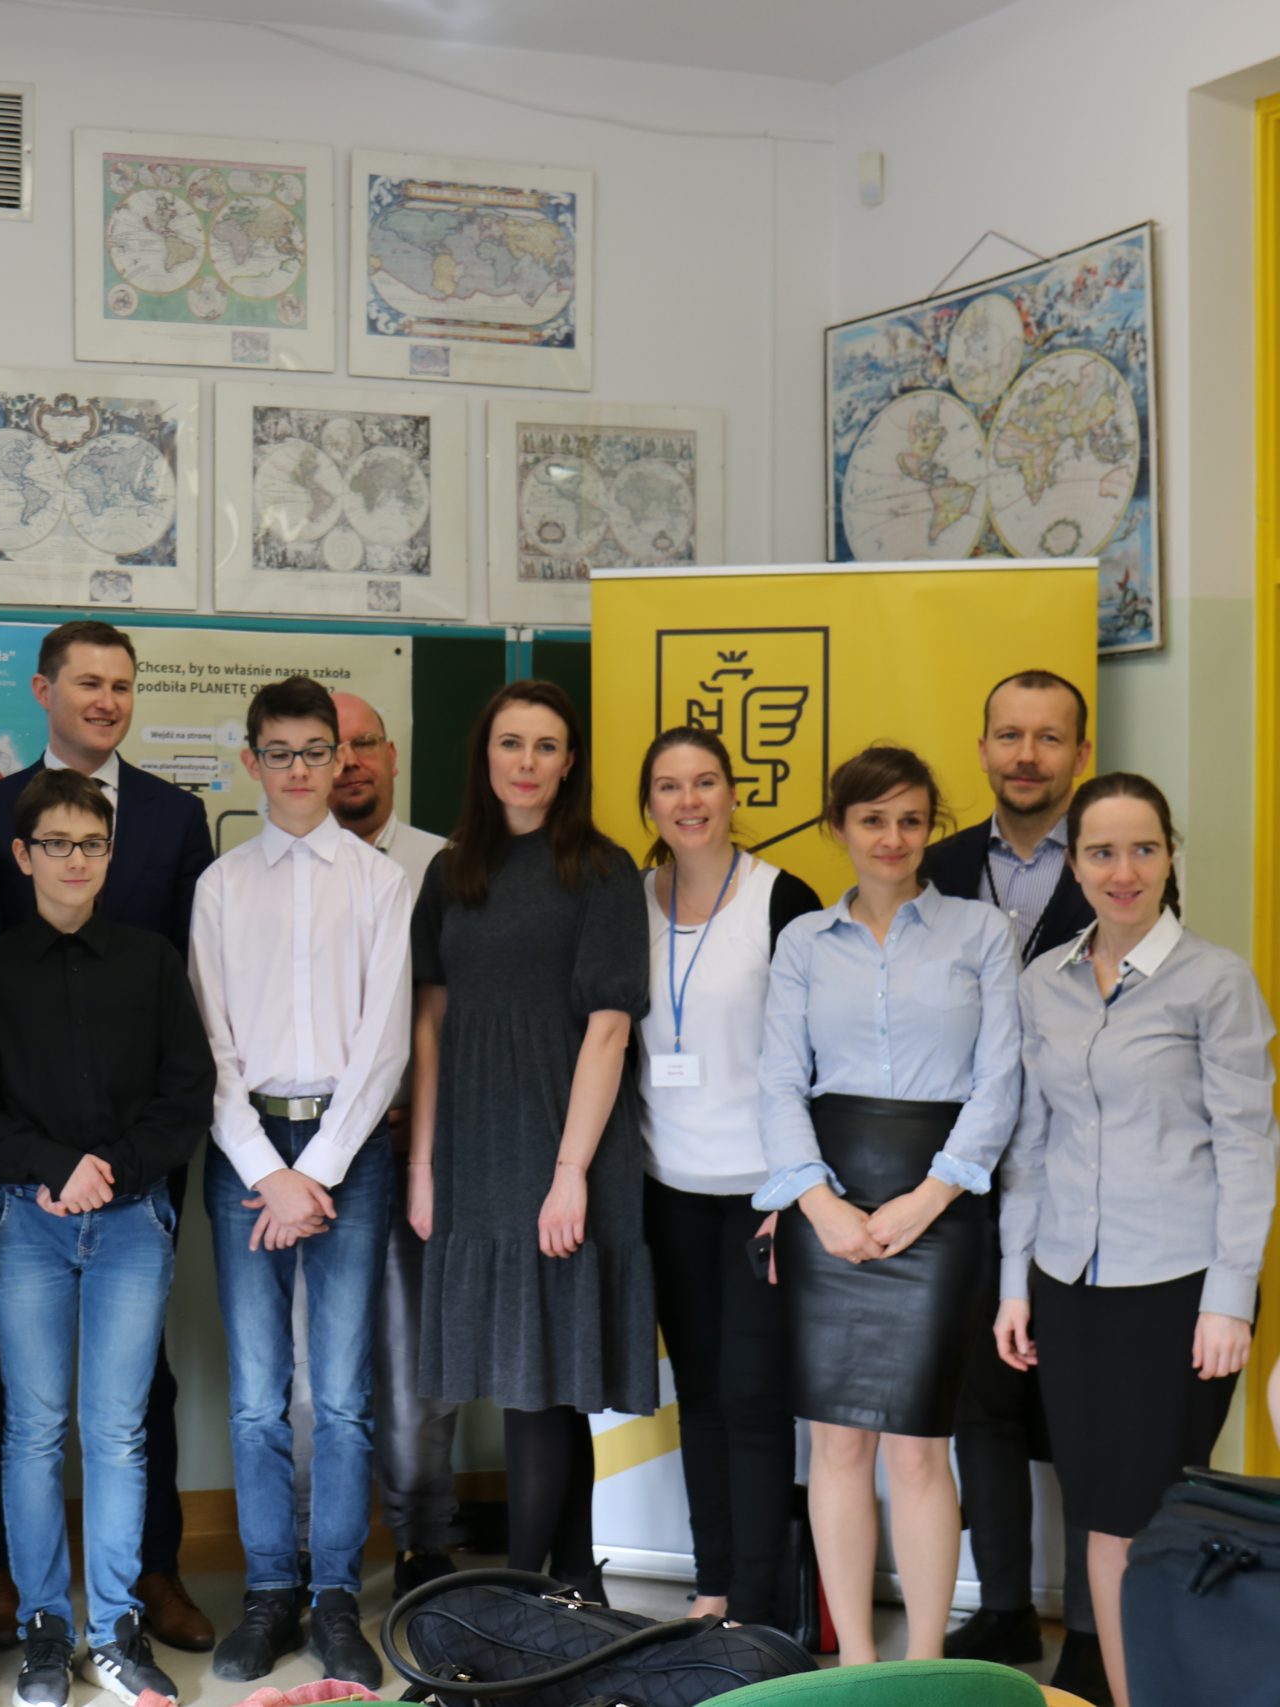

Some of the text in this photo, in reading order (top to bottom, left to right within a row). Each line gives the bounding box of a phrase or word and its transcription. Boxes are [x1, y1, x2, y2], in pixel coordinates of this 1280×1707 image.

[137, 661, 351, 679] Chcesz, by to właśnie nasza szkoła
[137, 681, 187, 695] podbiła
[190, 682, 246, 698] PLANETĘ
